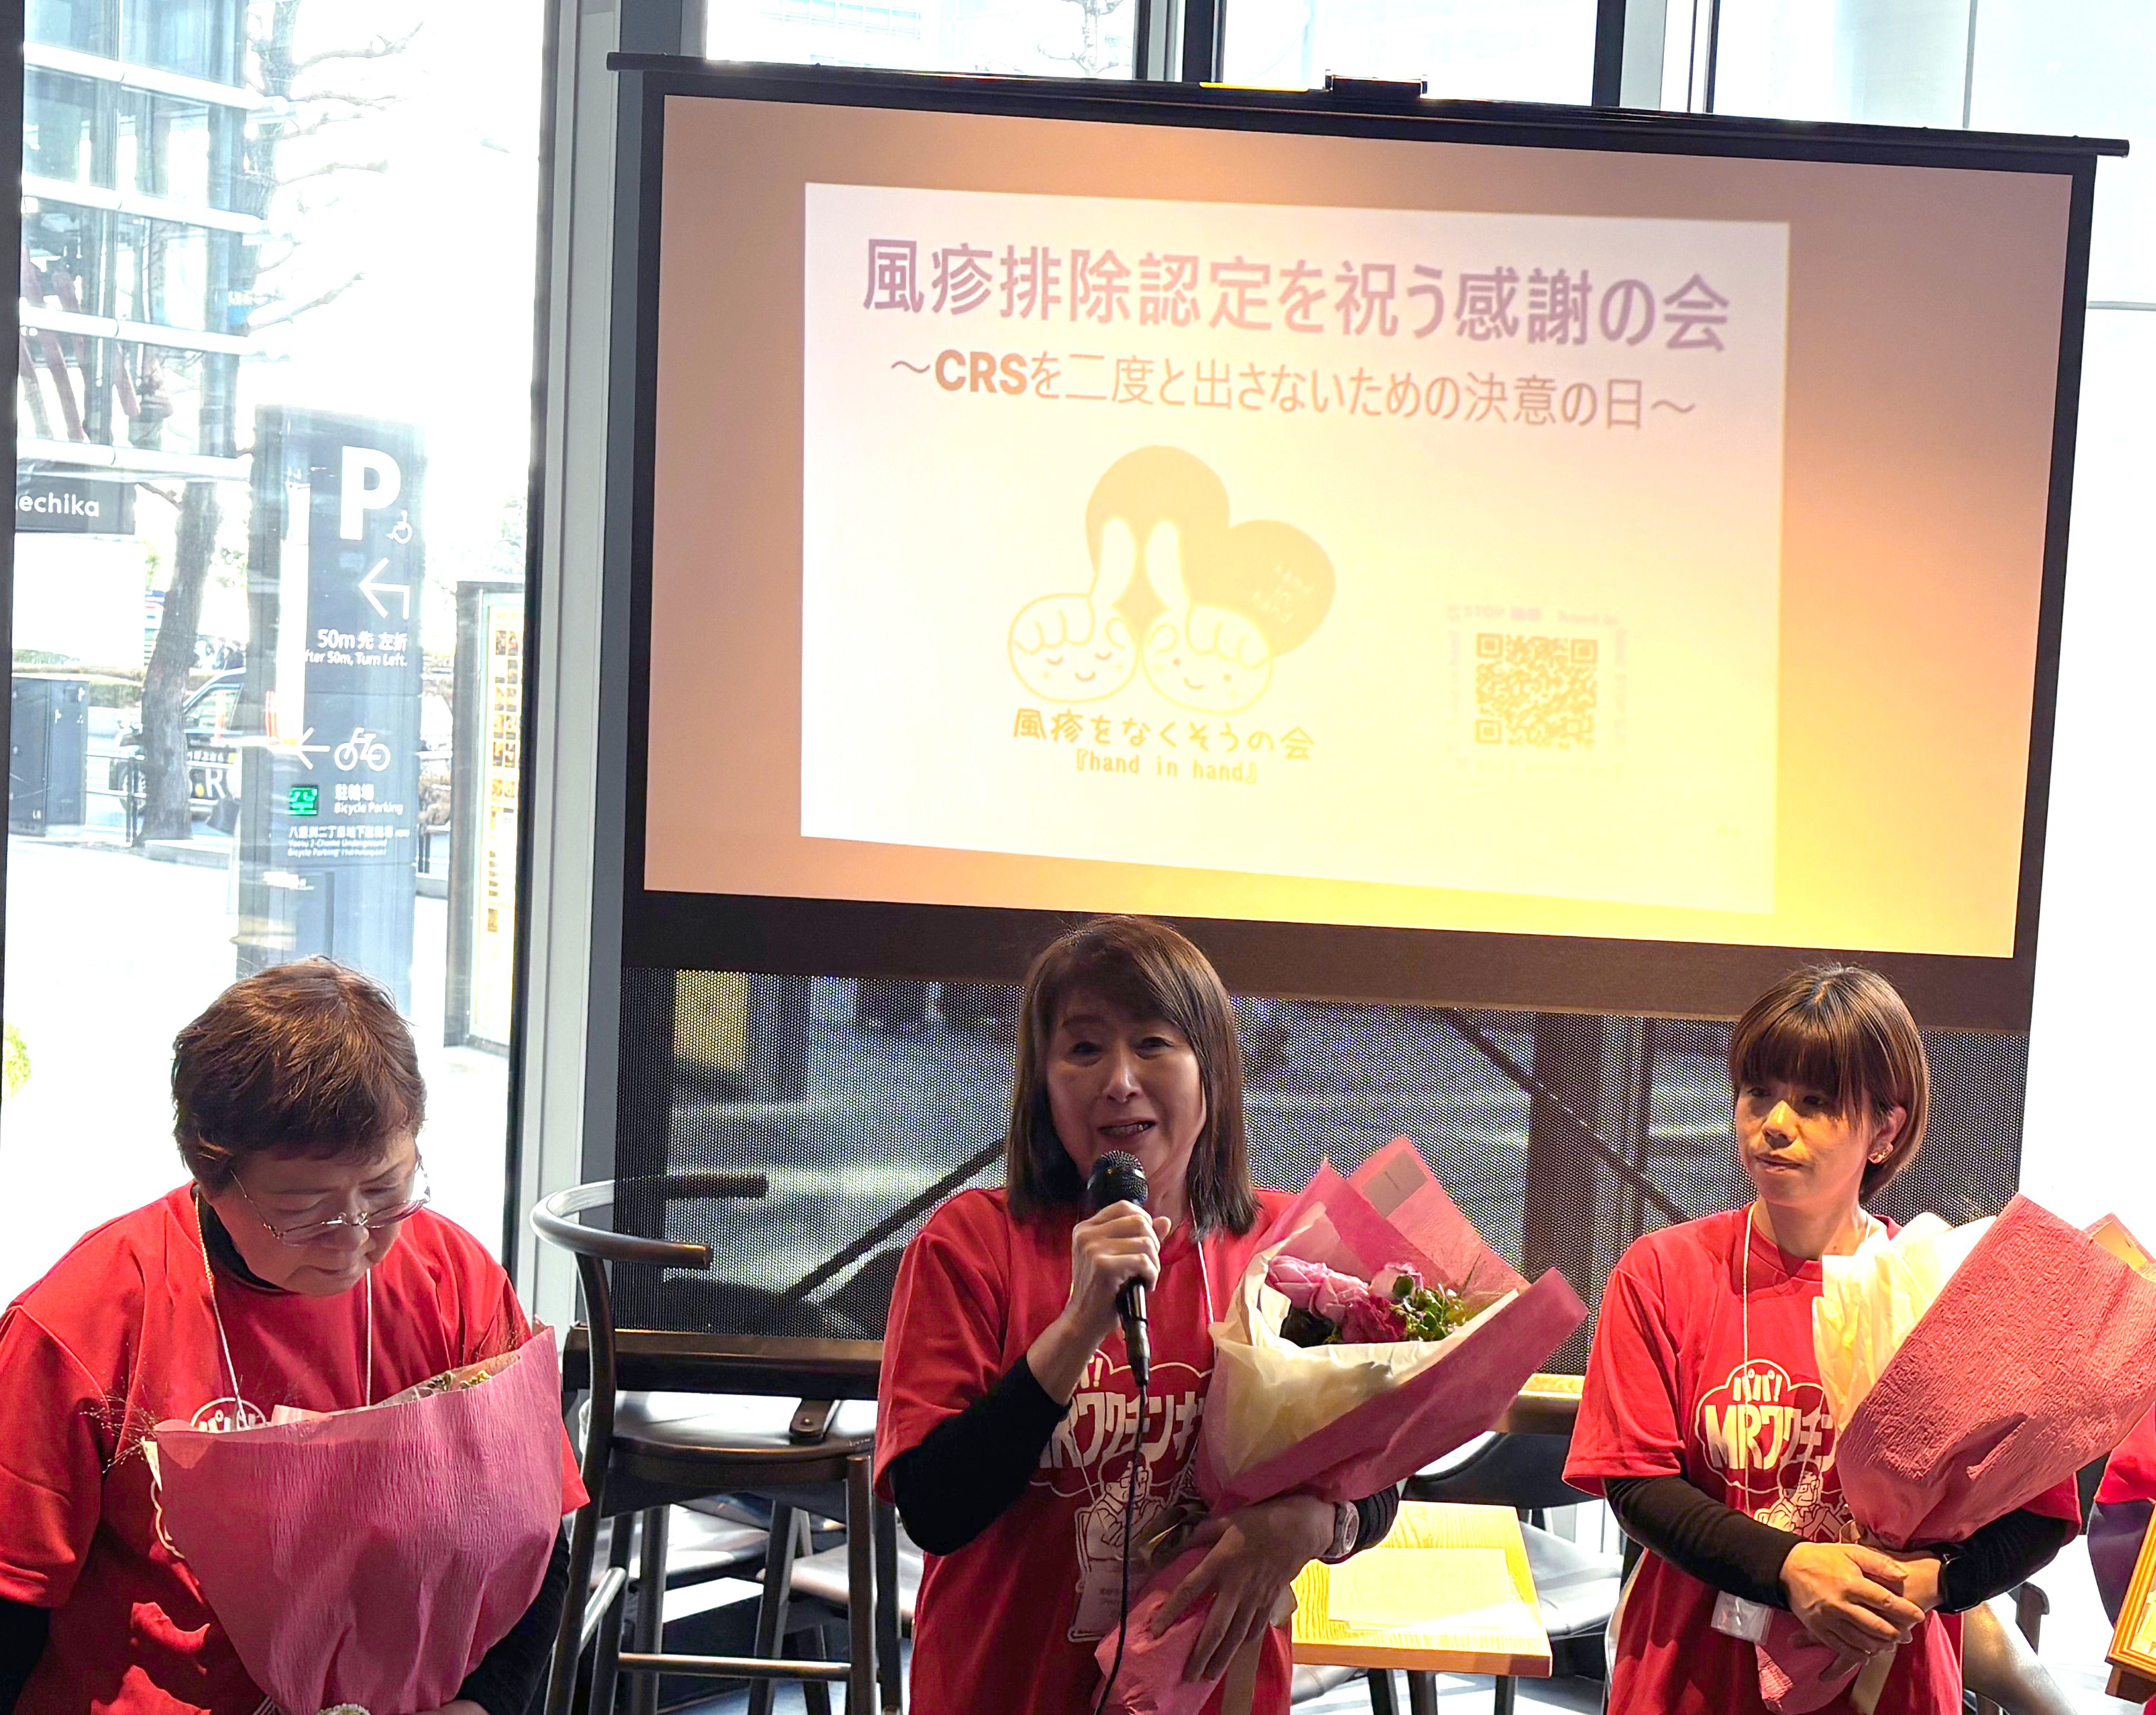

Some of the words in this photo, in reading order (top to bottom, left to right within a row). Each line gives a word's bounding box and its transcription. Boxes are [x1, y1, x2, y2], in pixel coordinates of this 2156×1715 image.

[863, 238, 1730, 352] 風疹排除認定を祝う感謝の会
[16, 492, 99, 517] echika
[340, 445, 401, 540] P
[1013, 708, 1315, 760] 風疹をなくそうの会
